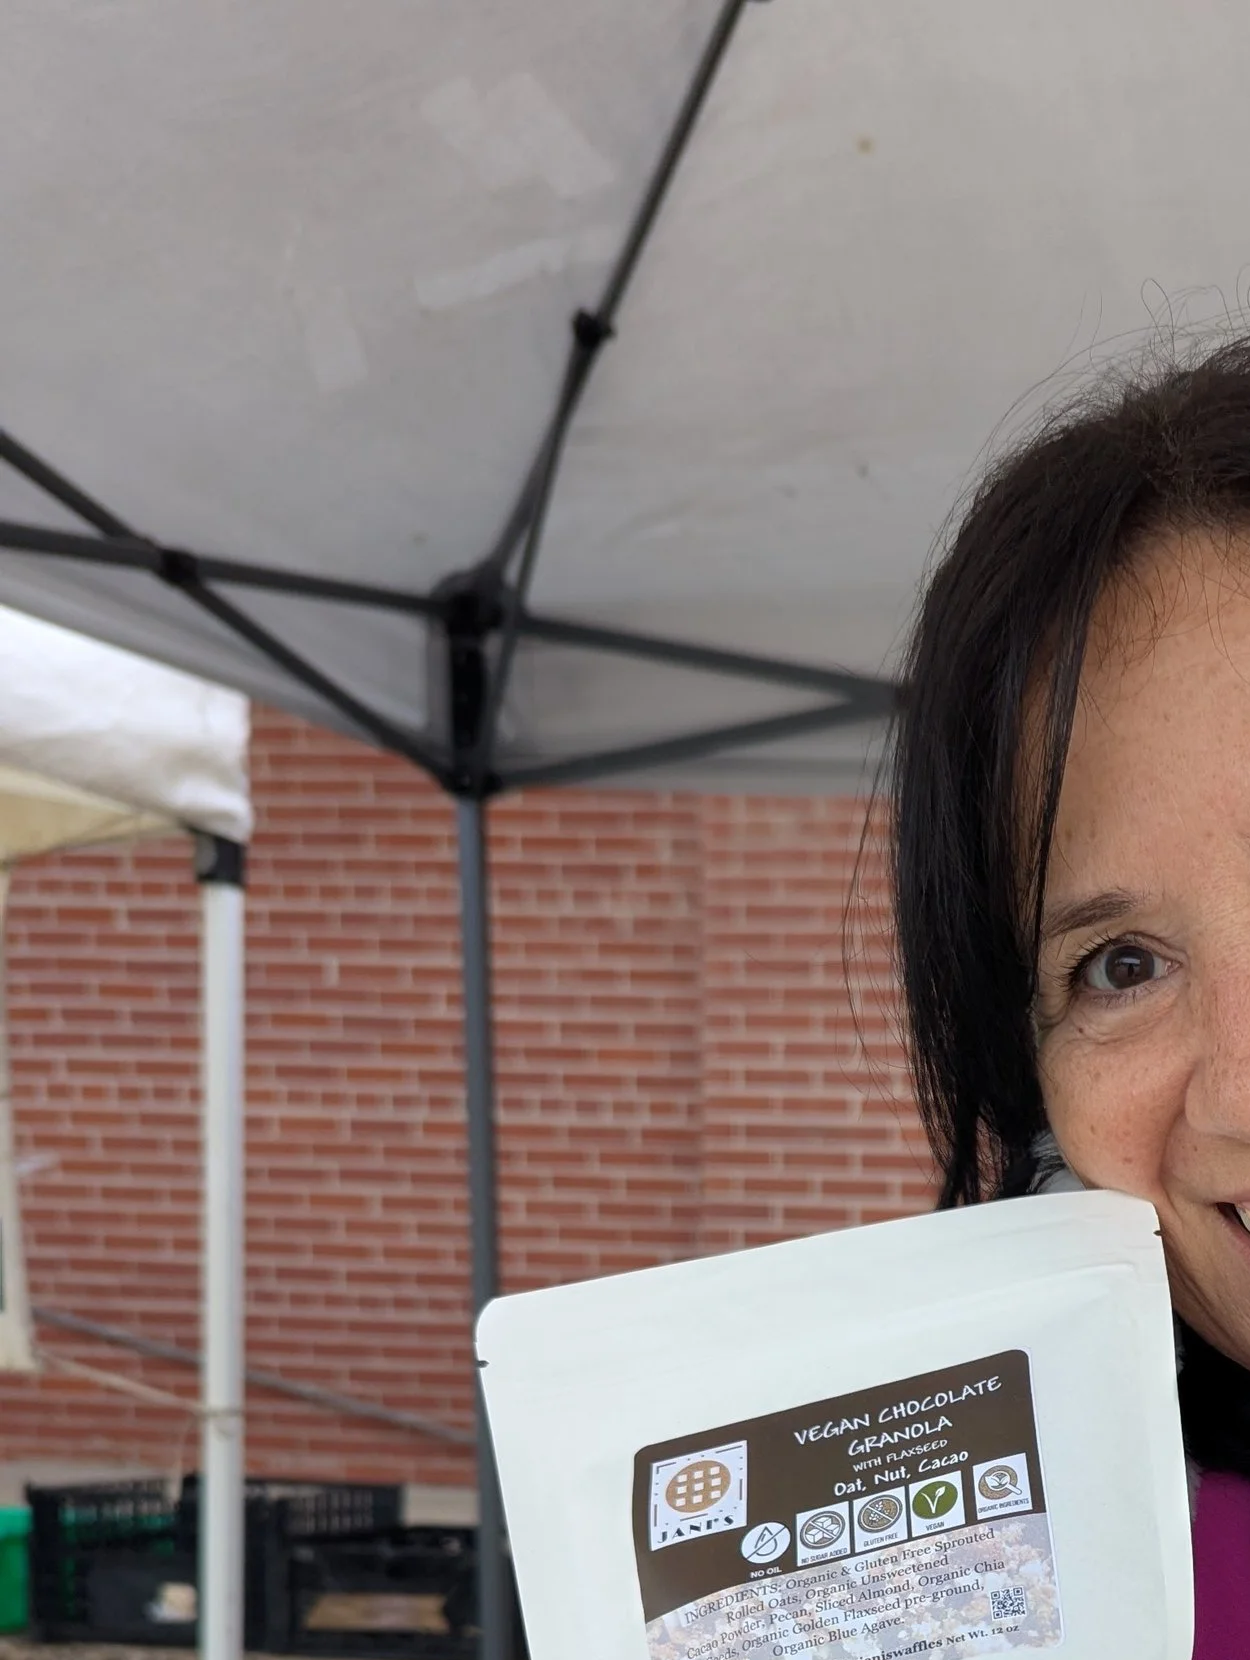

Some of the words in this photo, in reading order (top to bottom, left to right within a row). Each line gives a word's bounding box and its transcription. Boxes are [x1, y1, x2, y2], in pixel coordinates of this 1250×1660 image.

[794, 1414, 870, 1445] VEGAN
[878, 1375, 1002, 1424] CHOCOLATE
[848, 1416, 952, 1457] GRANOLA
[853, 1457, 882, 1473] WITH
[887, 1439, 948, 1465] FLAXSEED
[834, 1480, 867, 1497] Oat,
[875, 1467, 911, 1485] Nut,
[918, 1450, 969, 1473] Cacao
[863, 1536, 884, 1547] GLUTEN
[885, 1532, 898, 1542] FREE
[926, 1521, 945, 1532] VEGAN
[684, 1582, 782, 1625] INGREDIENTS:
[785, 1572, 838, 1590] Organic
[840, 1565, 852, 1576] &
[854, 1555, 898, 1574] Gluten
[902, 1546, 932, 1560] Free
[934, 1528, 996, 1555] Sprouted
[750, 1569, 765, 1579] NO
[766, 1566, 782, 1576] OIL
[801, 1557, 809, 1565] NO
[810, 1551, 828, 1562] SUGAR
[829, 1547, 849, 1559] ADDED
[687, 1640, 719, 1660] Cacao
[720, 1620, 766, 1645] Powder,
[769, 1608, 813, 1625] Pecan,
[815, 1594, 854, 1613] Sliced
[858, 1582, 915, 1603] Almond,
[918, 1567, 971, 1587] Organic
[974, 1559, 1006, 1574] Chia
[726, 1603, 765, 1624] Rolled
[768, 1595, 801, 1609] Oats,
[805, 1580, 858, 1599] Organic
[861, 1556, 950, 1586] Unsweetened
[742, 1630, 789, 1652] Organic
[792, 1616, 840, 1635] Golden
[843, 1598, 901, 1622] Flaxseed
[903, 1579, 985, 1609] pre-ground,
[946, 1633, 966, 1646] Net
[968, 1629, 988, 1640] Wt.
[991, 1626, 1004, 1635] 12
[1006, 1623, 1020, 1633] oz
[772, 1636, 825, 1657] Organic
[828, 1625, 858, 1643] Blue
[861, 1616, 905, 1637] Agave.
